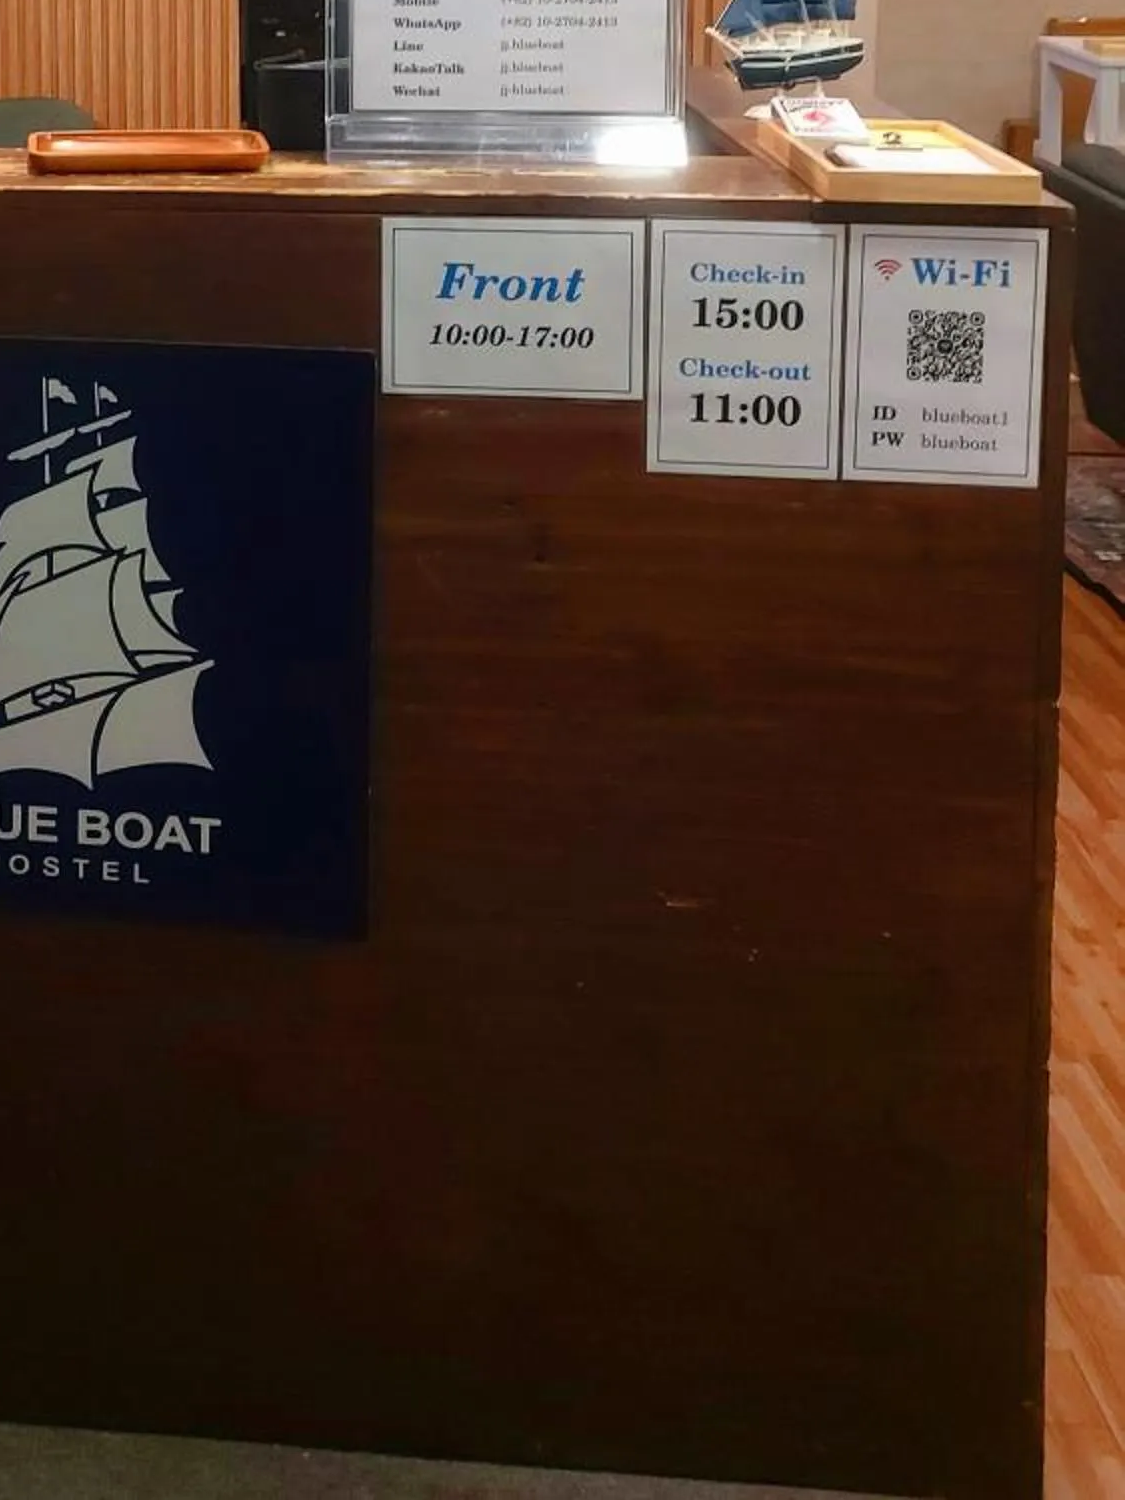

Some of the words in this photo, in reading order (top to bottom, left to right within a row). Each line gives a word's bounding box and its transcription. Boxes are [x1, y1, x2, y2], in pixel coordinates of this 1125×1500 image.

[393, 18, 461, 30] WhatsApp
[393, 41, 424, 51] Line
[393, 64, 464, 74] KakaoTalk
[393, 86, 440, 97] Wechat
[437, 263, 585, 303] Front
[690, 262, 805, 285] Check-in
[911, 258, 1012, 288] Wi-Fi
[692, 298, 804, 331] 15:00
[430, 324, 594, 350] 10:00-17:00
[678, 358, 811, 381] Check-out
[690, 393, 801, 427] 11:00
[872, 405, 896, 421] ID
[922, 407, 1008, 426] blueboat1
[872, 431, 905, 447] PW
[921, 434, 998, 451] blueboat
[77, 809, 222, 854] BOAT
